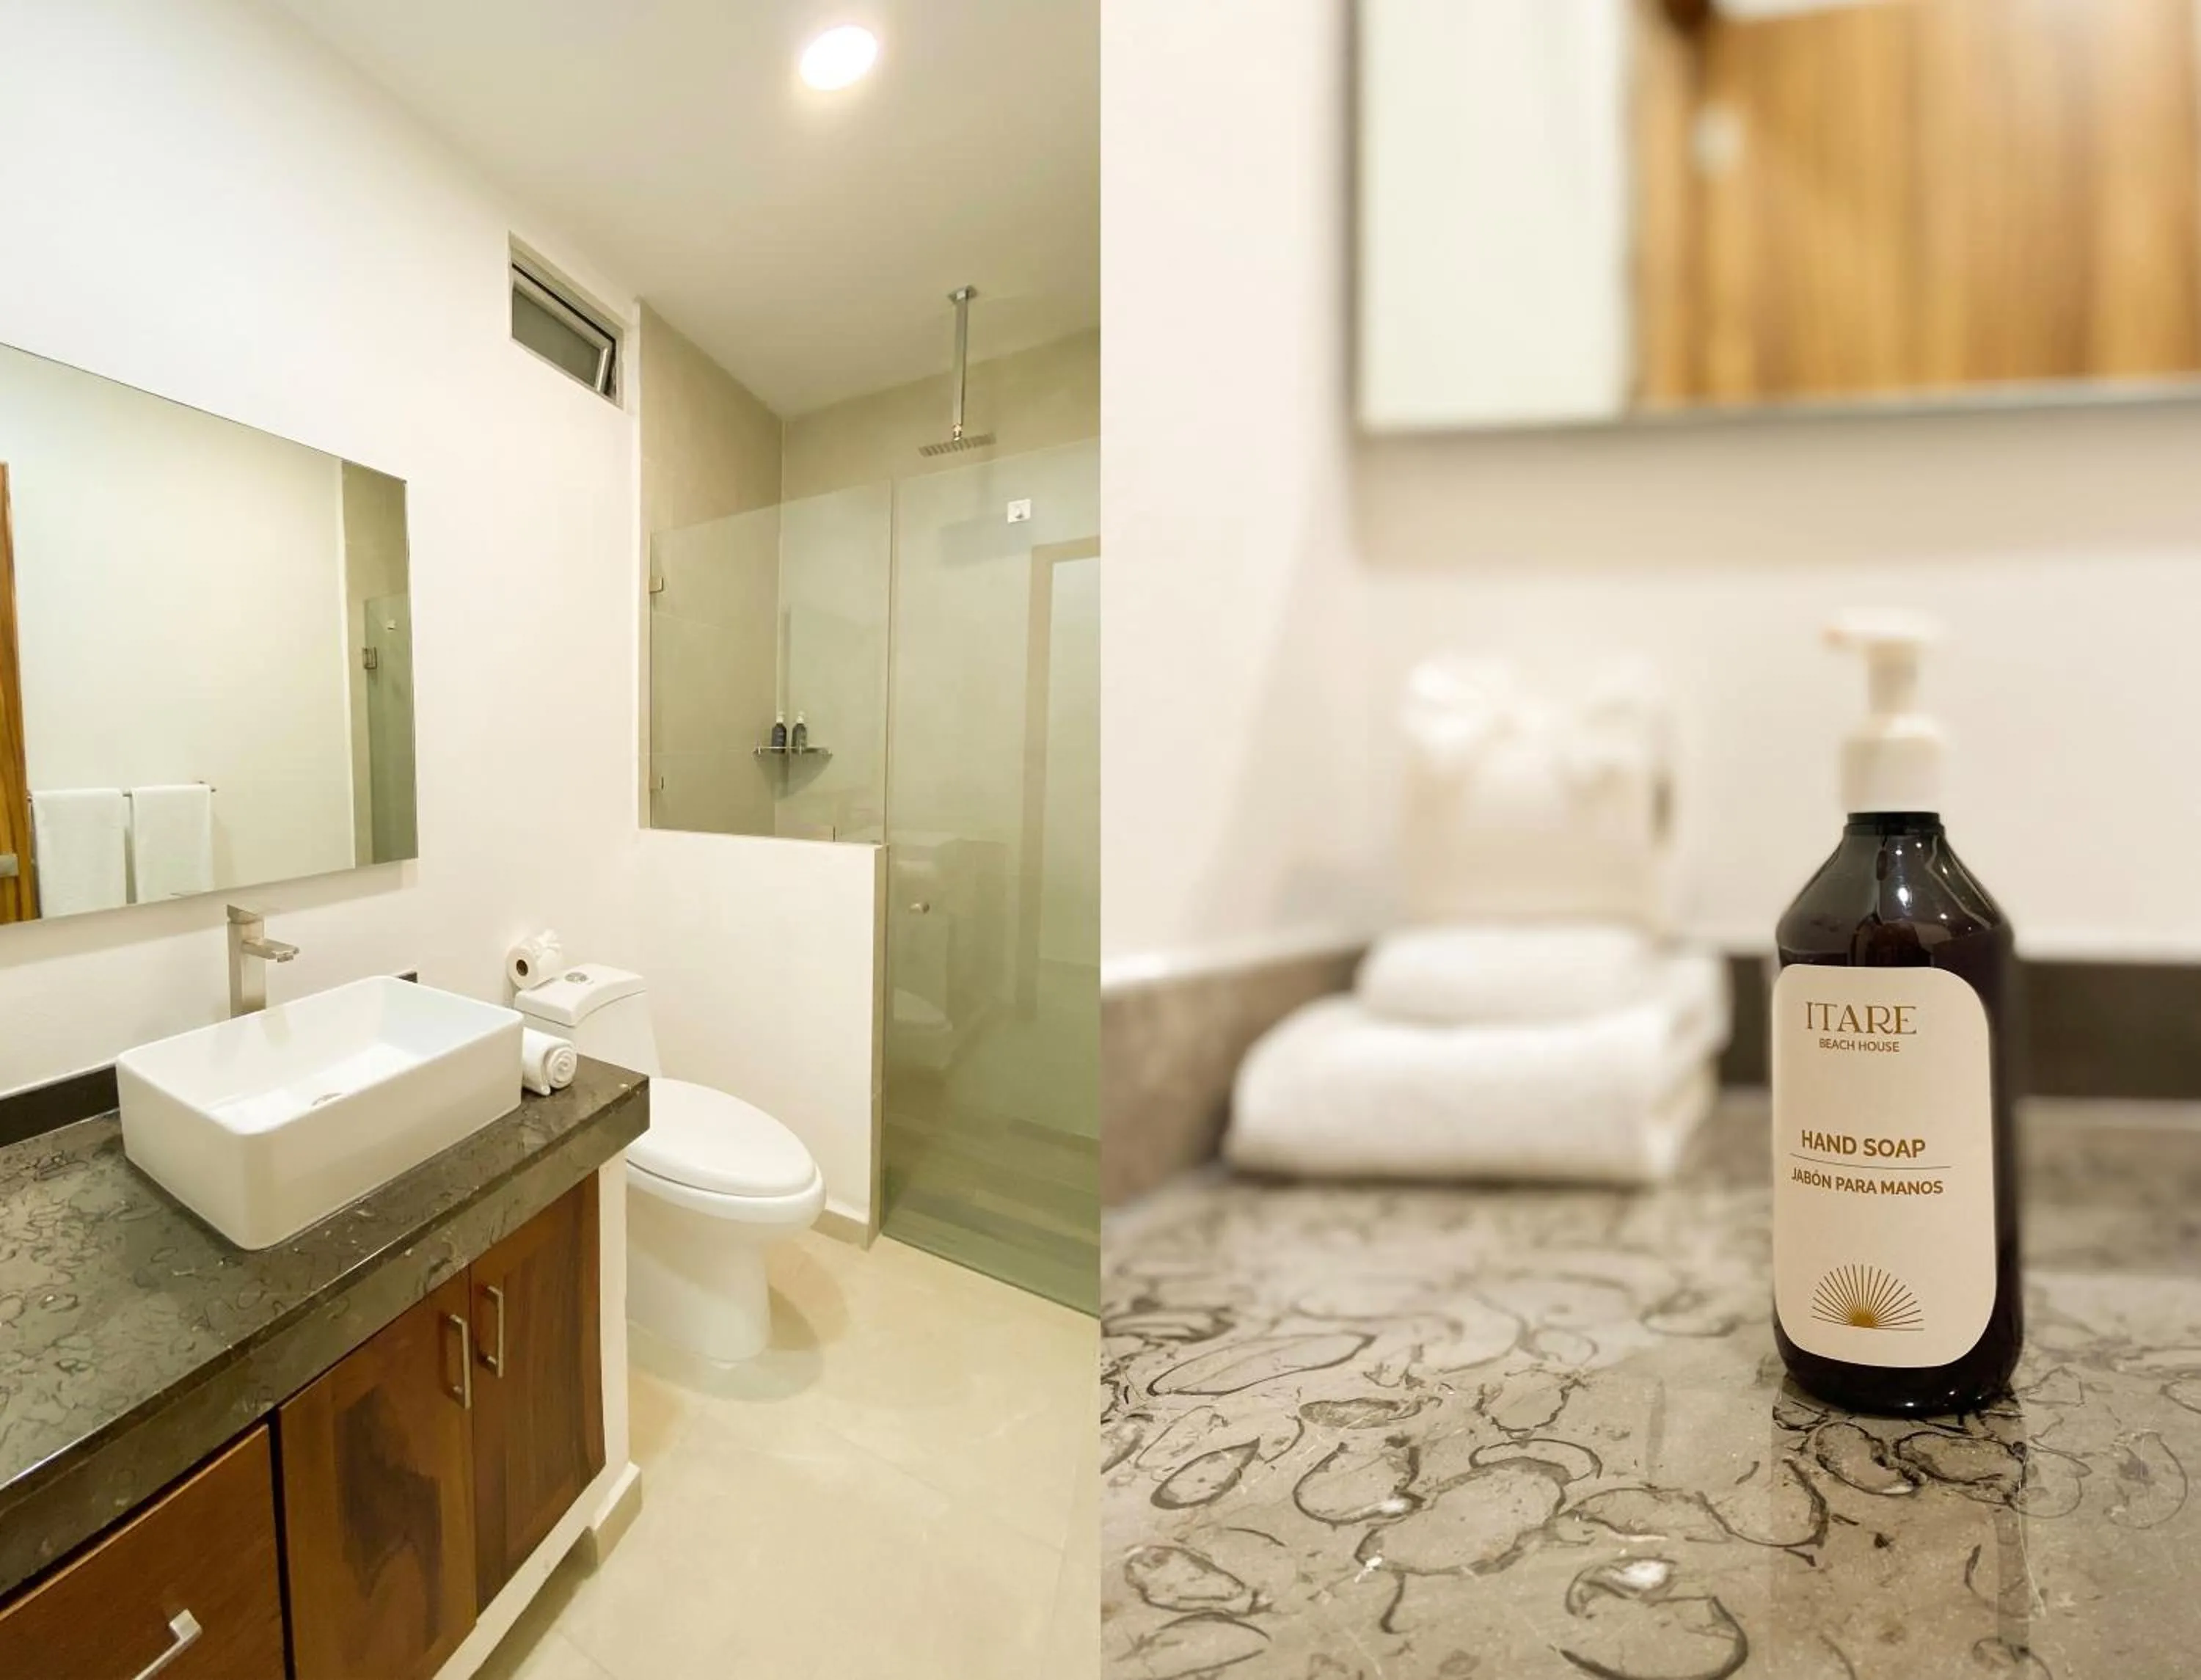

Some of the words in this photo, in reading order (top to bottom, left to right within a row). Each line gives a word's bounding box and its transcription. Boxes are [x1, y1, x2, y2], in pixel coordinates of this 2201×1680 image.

[1806, 1001, 1917, 1035] ITARE
[1819, 1038, 1855, 1051] BEACH
[1858, 1040, 1900, 1053] HOUSE
[1801, 1130, 1857, 1155] HAND
[1863, 1138, 1926, 1158] SOAP
[1791, 1167, 1831, 1189] JABÓN
[1836, 1176, 1877, 1194] PARA
[1880, 1180, 1943, 1195] MANOS
